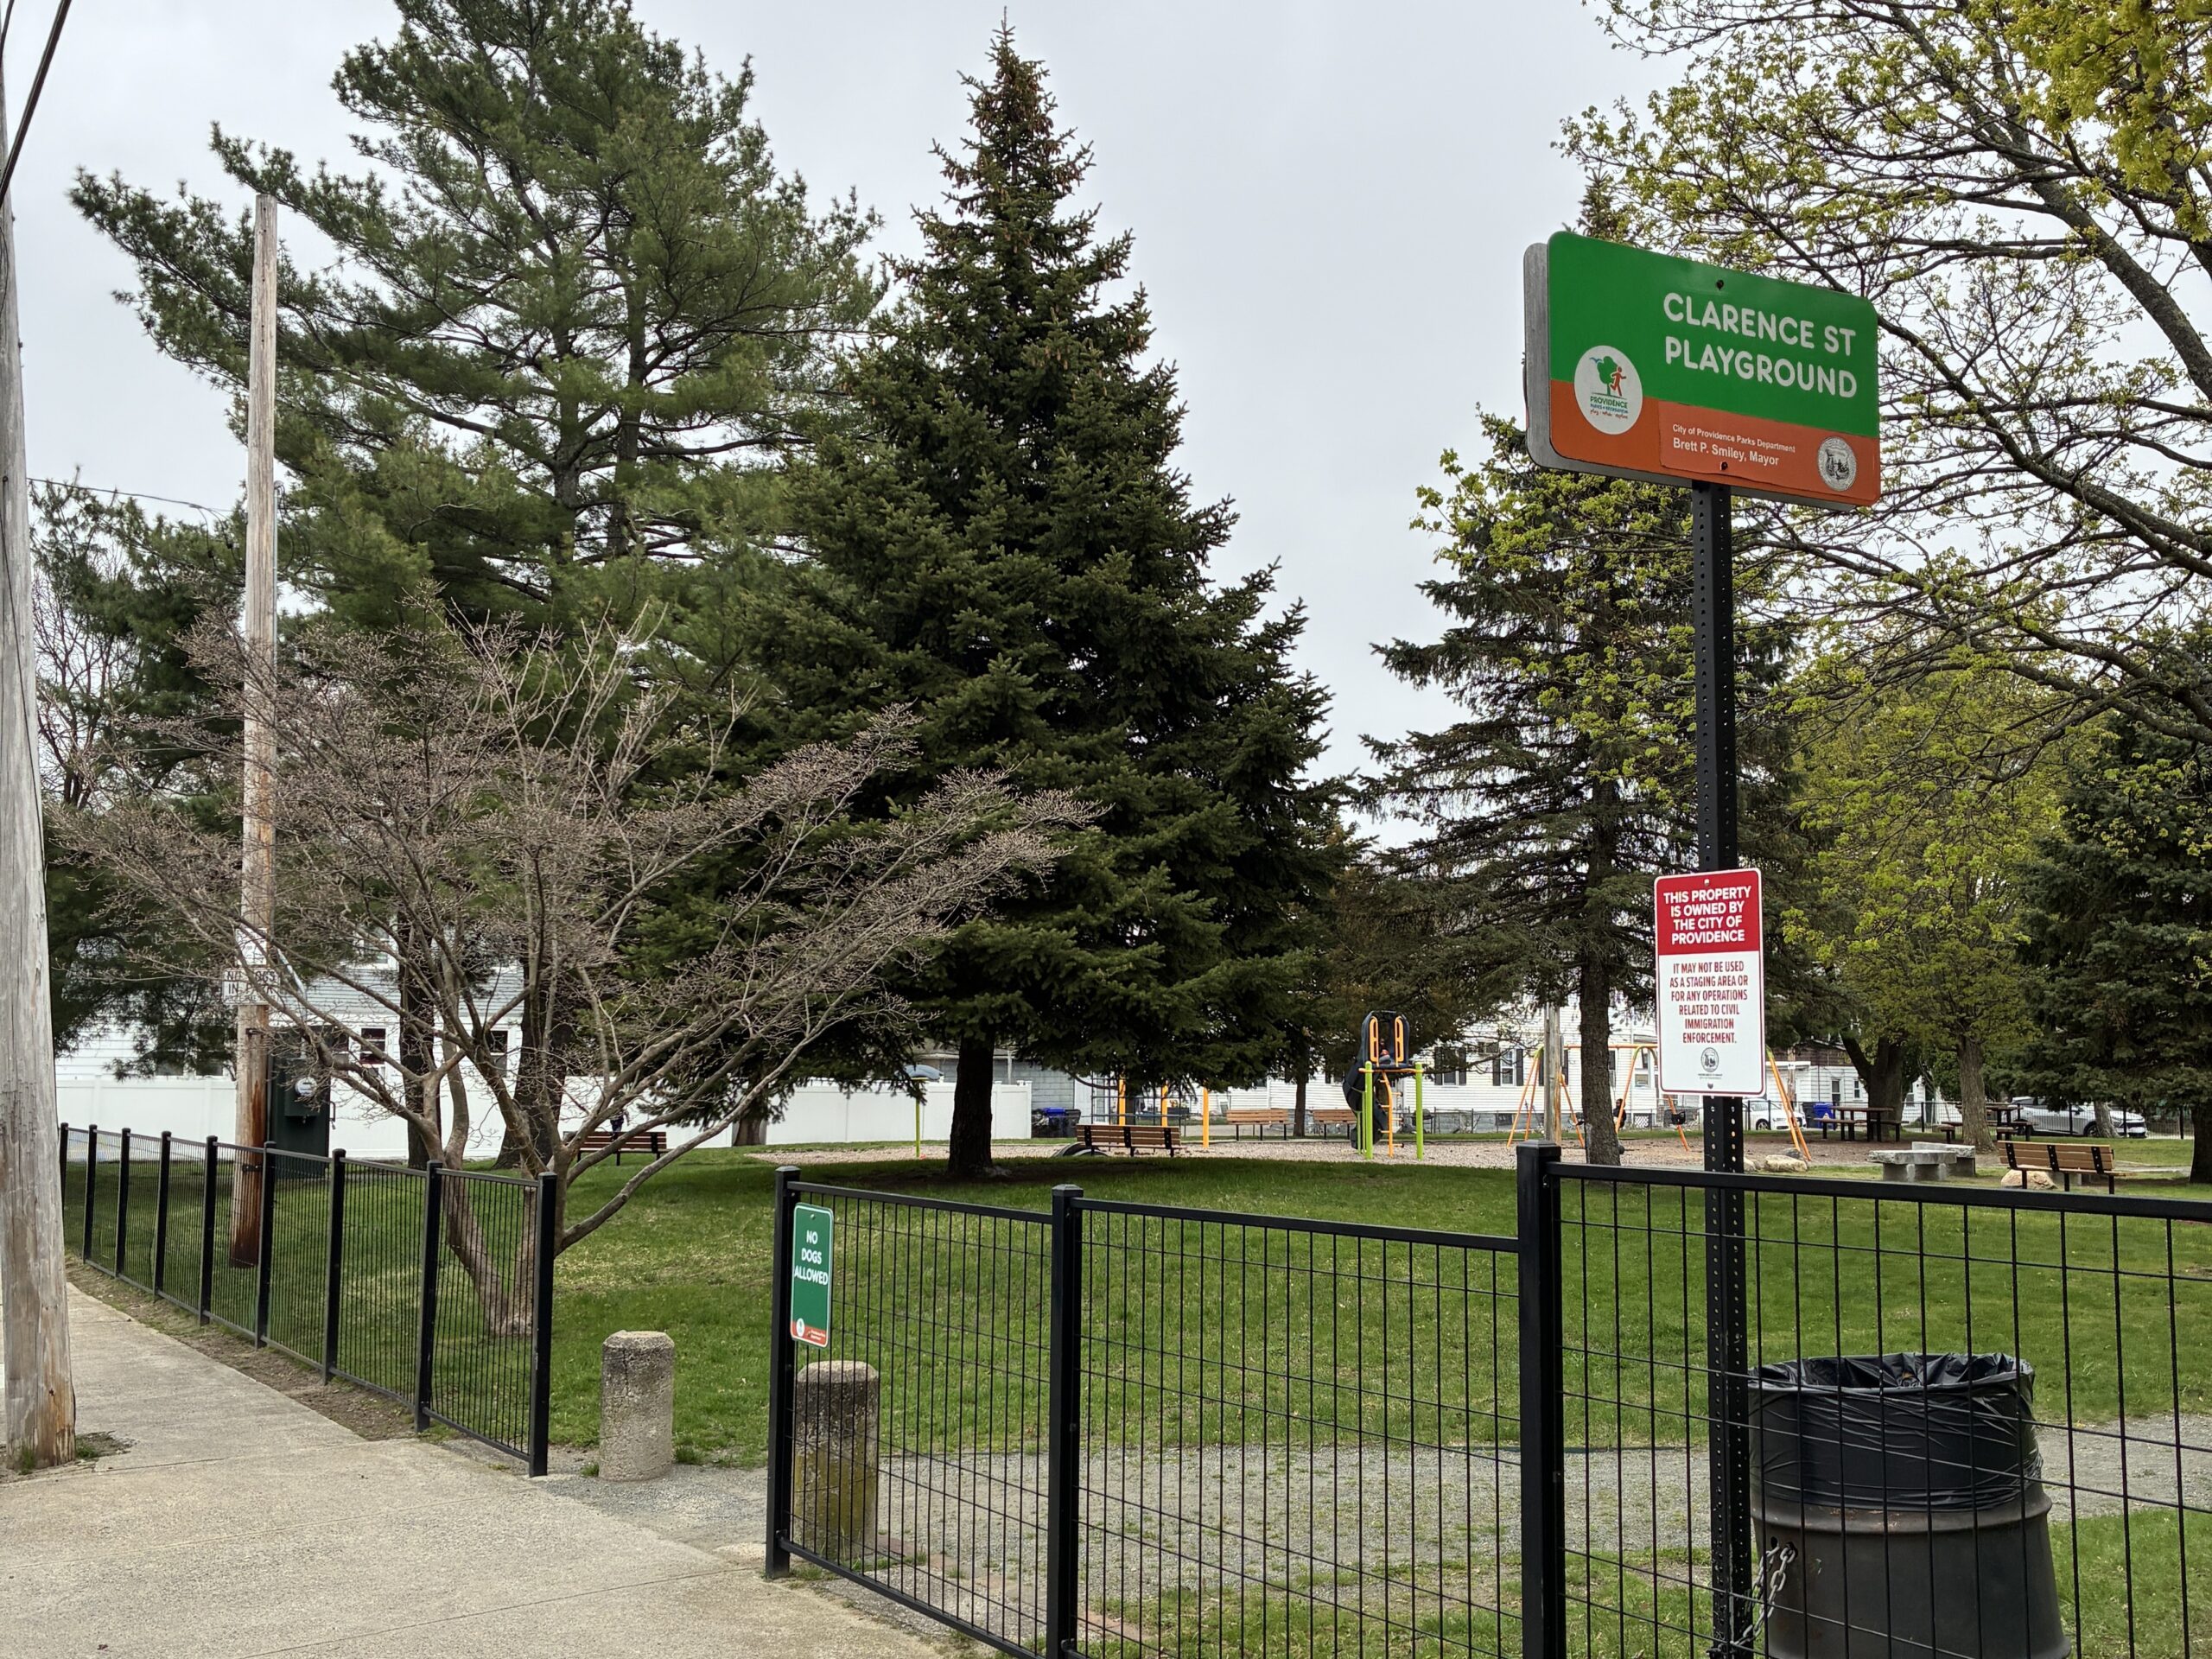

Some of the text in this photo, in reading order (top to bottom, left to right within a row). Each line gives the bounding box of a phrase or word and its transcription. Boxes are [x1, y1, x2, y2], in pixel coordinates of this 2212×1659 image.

[1663, 292, 1856, 356] CLARENCE ST
[1665, 336, 1857, 398] PLAYGROUND
[1590, 396, 1628, 409] PROVIDENCE
[1673, 423, 1686, 435] City
[1697, 429, 1735, 442] Providence
[1737, 435, 1756, 446] Parks
[1758, 439, 1796, 453] Department
[1673, 437, 1780, 467] Brett P. Smiley, Mayor
[1663, 886, 1751, 904] THIS PROPERTY
[1670, 900, 1745, 918] IS OWNED BY
[1673, 915, 1742, 931] THE CITY OF
[1672, 929, 1745, 945] PROVIDENCE
[1673, 961, 1744, 974] IT MAY NOT BE USED
[1670, 975, 1748, 988] AS A STAGING AREA OR
[1671, 989, 1748, 1001] FOR ANY OPERATIONS
[1679, 1003, 1739, 1015] RELATED TO CIVIL
[1685, 1018, 1734, 1029] IMMIGRATION
[1682, 1033, 1737, 1044] ENFORCEMENT.
[806, 1230, 818, 1244] NO
[801, 1248, 822, 1264] DOGS
[794, 1265, 829, 1285] ALLOWED
